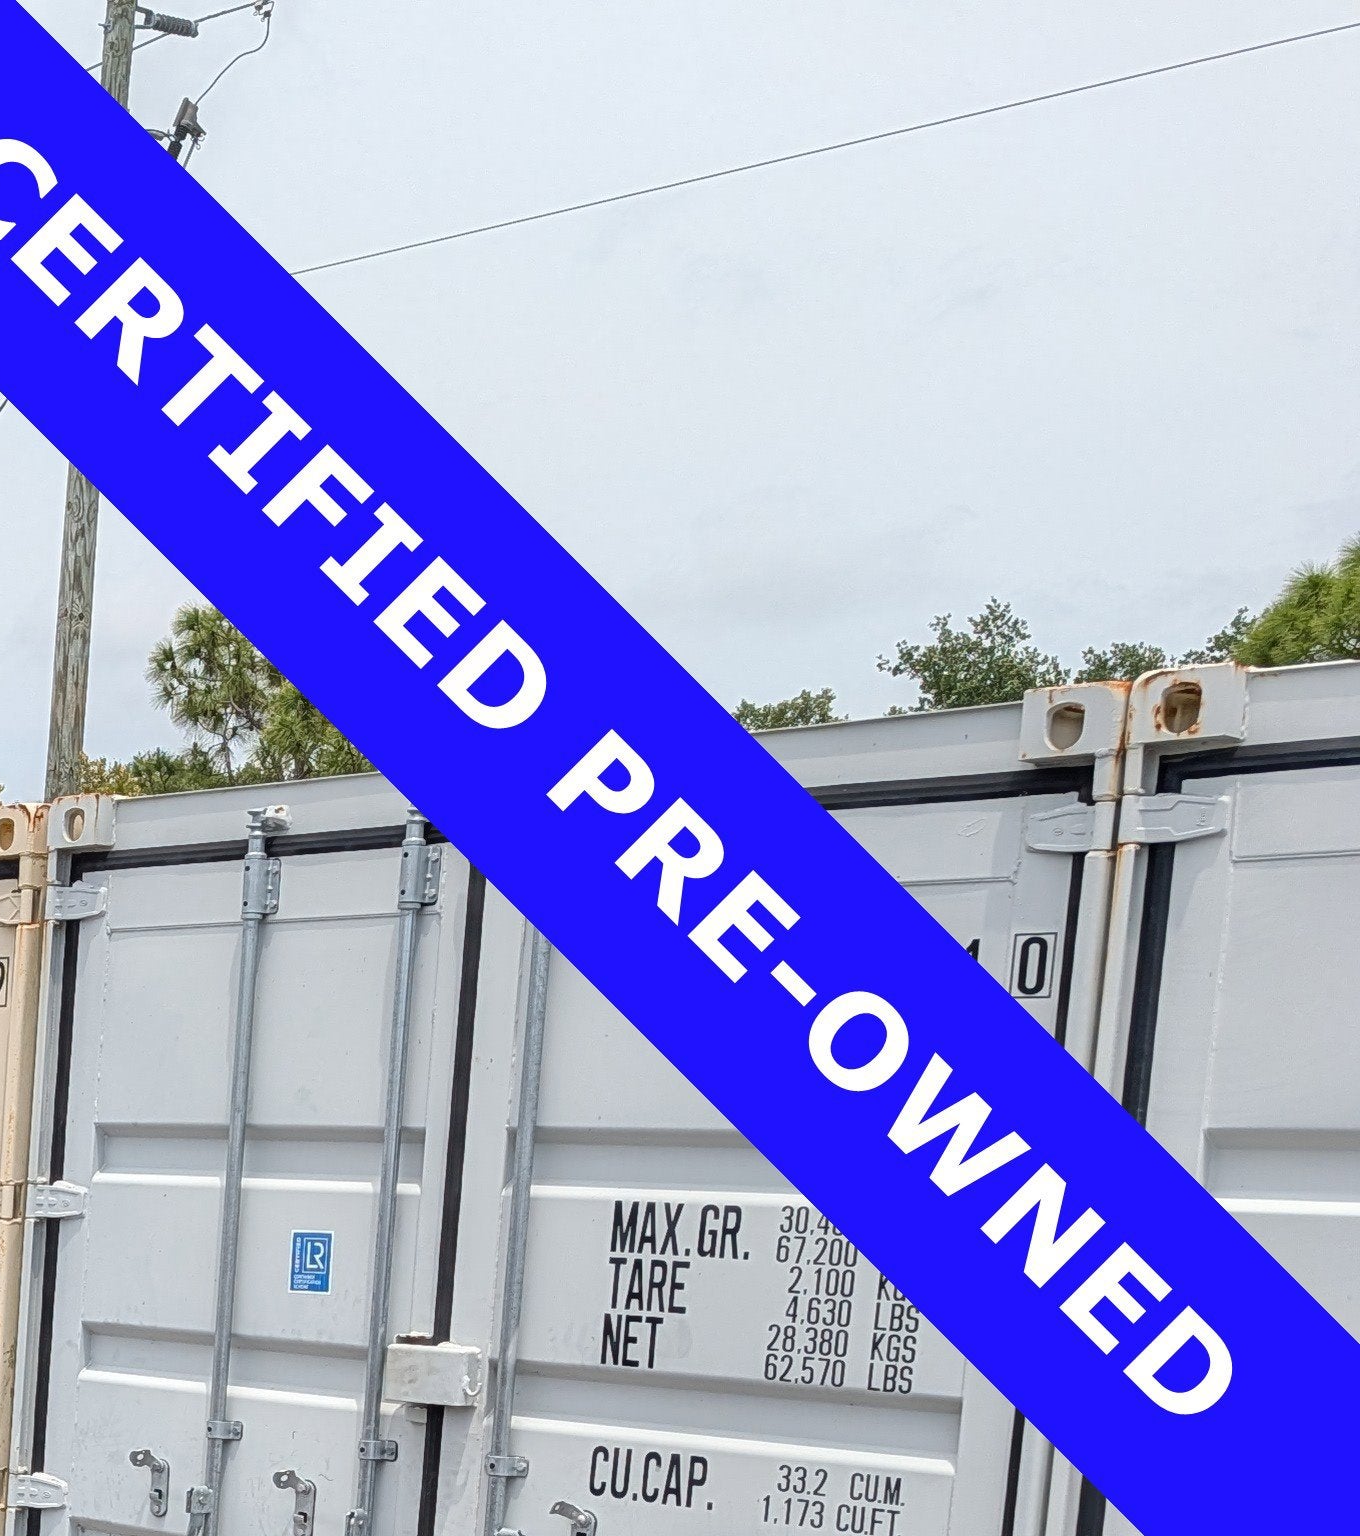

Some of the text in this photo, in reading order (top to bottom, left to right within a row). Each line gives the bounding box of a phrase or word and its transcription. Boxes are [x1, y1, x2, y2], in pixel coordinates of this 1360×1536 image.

[608, 1257, 691, 1314] TARE
[874, 1302, 920, 1333] LBS
[601, 1313, 664, 1369] NET
[870, 1333, 917, 1363] KGS
[867, 1364, 914, 1394] LBS
[777, 1464, 828, 1496] 33.2
